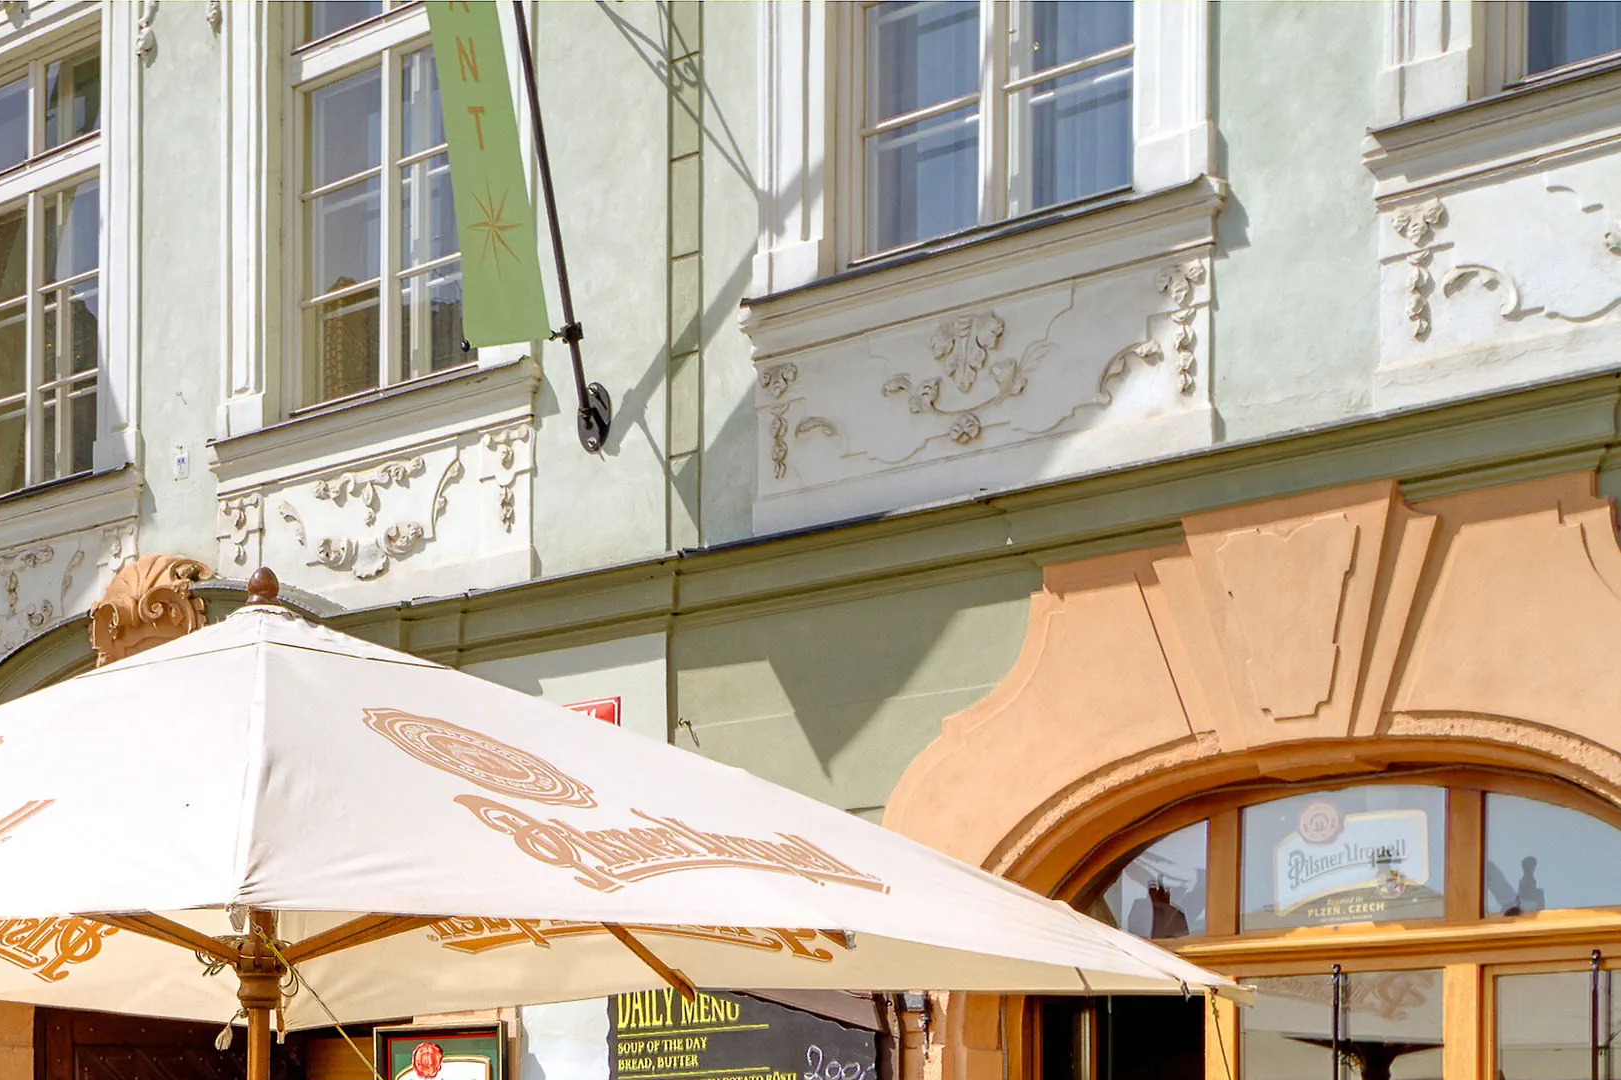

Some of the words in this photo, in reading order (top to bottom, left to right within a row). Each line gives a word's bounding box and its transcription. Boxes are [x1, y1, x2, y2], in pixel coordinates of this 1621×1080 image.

[1288, 849, 1346, 890] Pilsner
[1344, 838, 1406, 868] Urquell
[618, 1042, 644, 1055] SOUP
[647, 1041, 660, 1053] OF
[662, 1039, 683, 1052] THE
[685, 1036, 707, 1050] DAY
[658, 1055, 699, 1068] BUTTER
